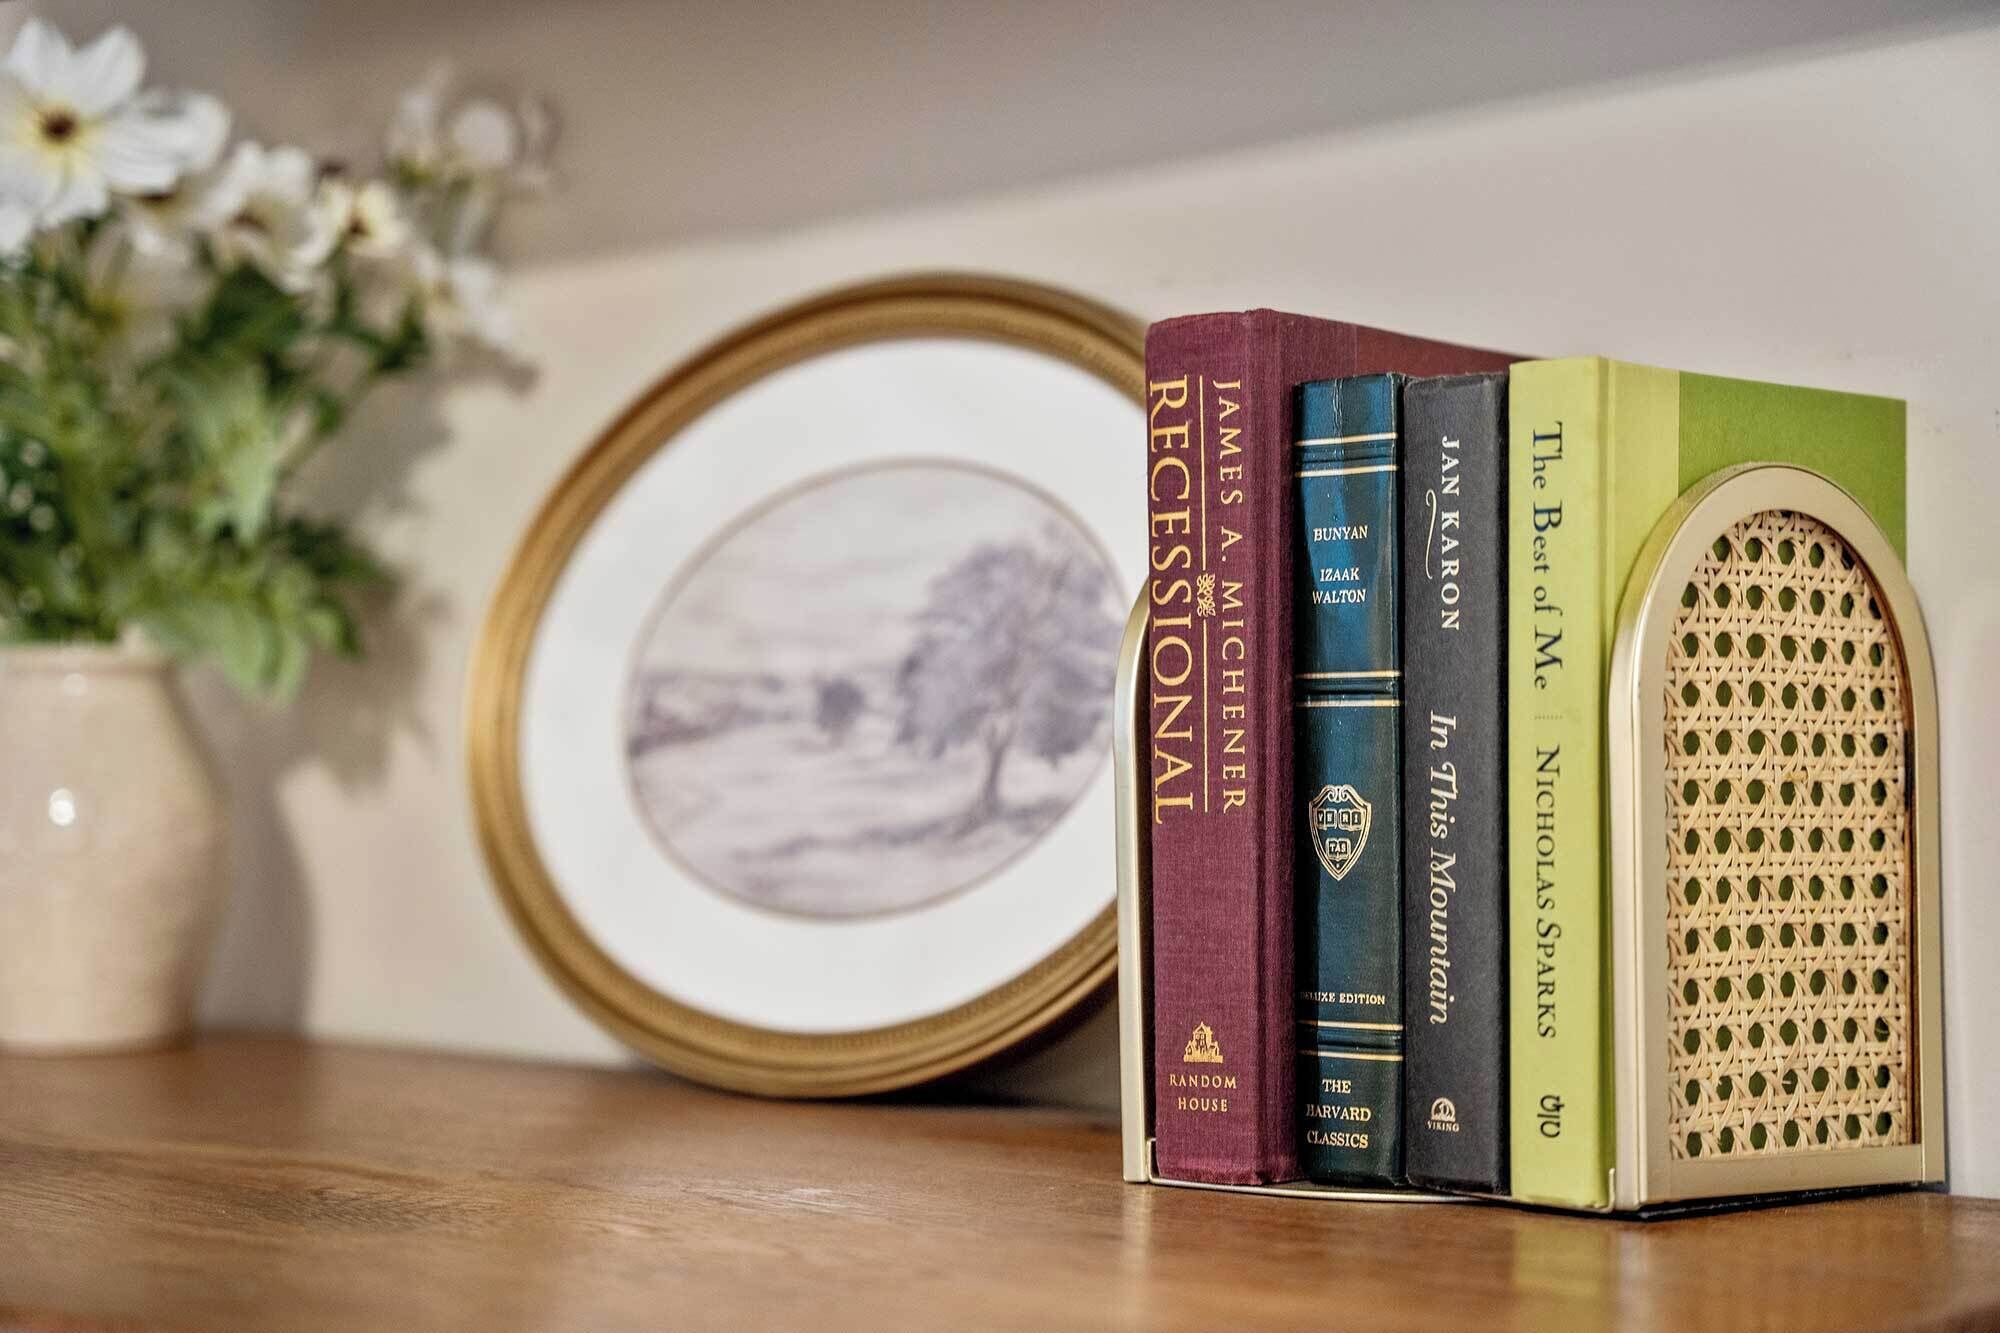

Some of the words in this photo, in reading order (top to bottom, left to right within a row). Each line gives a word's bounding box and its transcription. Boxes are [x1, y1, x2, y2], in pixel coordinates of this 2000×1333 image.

[1213, 379, 1243, 505] JAMES
[1532, 421, 1563, 490] The
[1441, 435, 1460, 497] JAN
[1221, 526, 1243, 562] A.
[1313, 525, 1368, 542] BUNYAN
[1532, 500, 1563, 573] Best
[1320, 567, 1360, 582] IZAAK
[1441, 510, 1460, 631] KARON
[1149, 374, 1194, 825] RECESSIONAL
[1312, 588, 1367, 604] WALTON
[1533, 586, 1563, 617] of
[1534, 627, 1563, 690] Me
[1221, 580, 1246, 814] MICHENER
[1429, 710, 1457, 750] In
[1429, 760, 1459, 839] This
[1536, 744, 1560, 911] NICHOLAS
[1429, 848, 1457, 1025] Mountain
[1339, 992, 1386, 1005] EDITION
[1536, 918, 1562, 1039] SPARKS
[1169, 1073, 1237, 1089] RANDOM
[1322, 1078, 1351, 1094] THE
[1178, 1097, 1228, 1112] HOUSE
[1306, 1104, 1372, 1122] HARVARD
[1306, 1130, 1369, 1149] CLASSICS
[1426, 1120, 1460, 1132] VIKING
